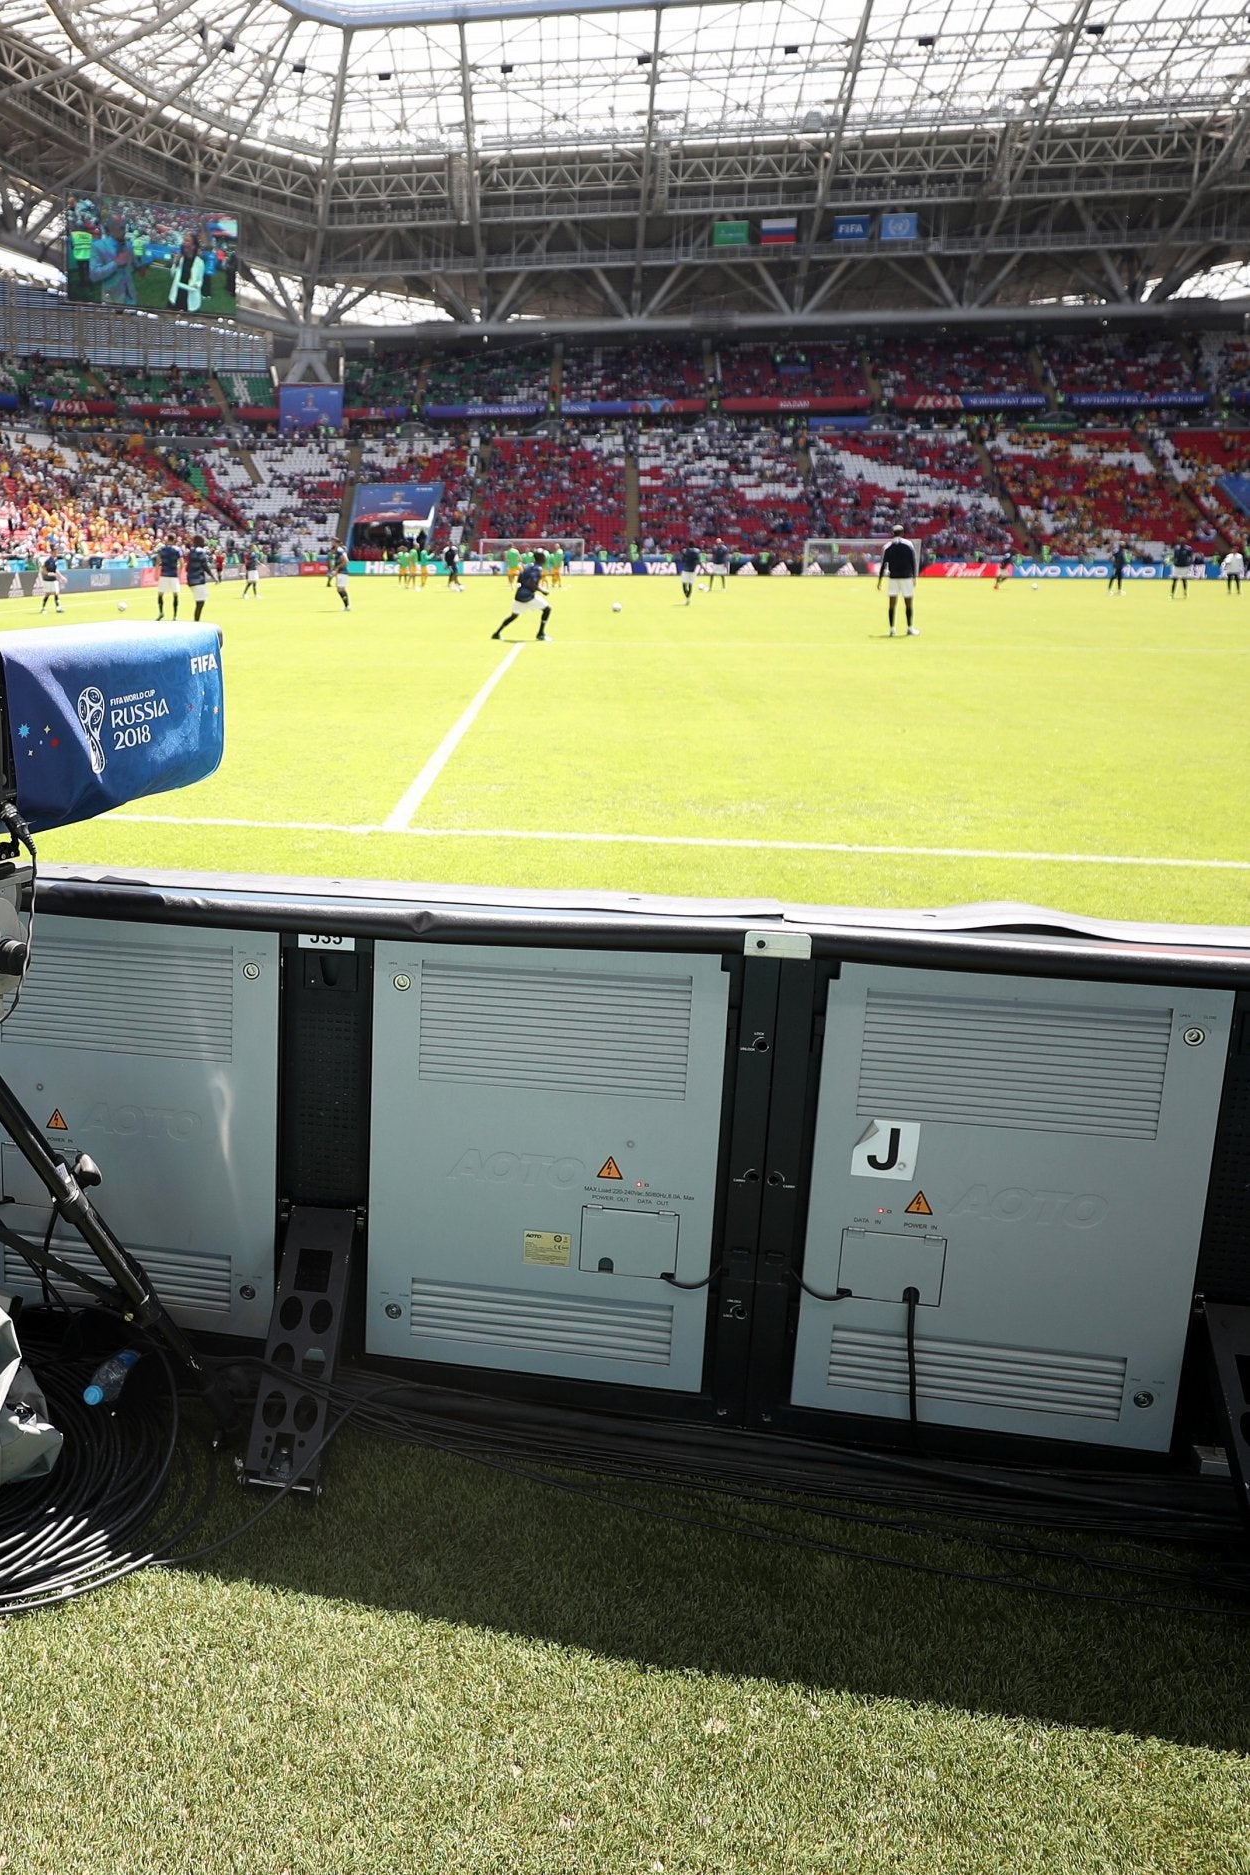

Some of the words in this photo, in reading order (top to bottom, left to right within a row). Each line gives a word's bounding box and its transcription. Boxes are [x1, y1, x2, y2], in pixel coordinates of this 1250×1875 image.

[838, 224, 864, 234] FIFA
[601, 562, 632, 575] VISA
[644, 562, 678, 575] VISA
[190, 653, 218, 675] FIFA
[110, 696, 124, 706] FIFA
[124, 692, 145, 704] WORLD
[144, 688, 156, 698] CUP
[110, 698, 170, 729] RUSSIA
[113, 724, 152, 750] 2018
[867, 1128, 900, 1170] J
[854, 1216, 870, 1226] DATA
[904, 1222, 928, 1230] POWER
